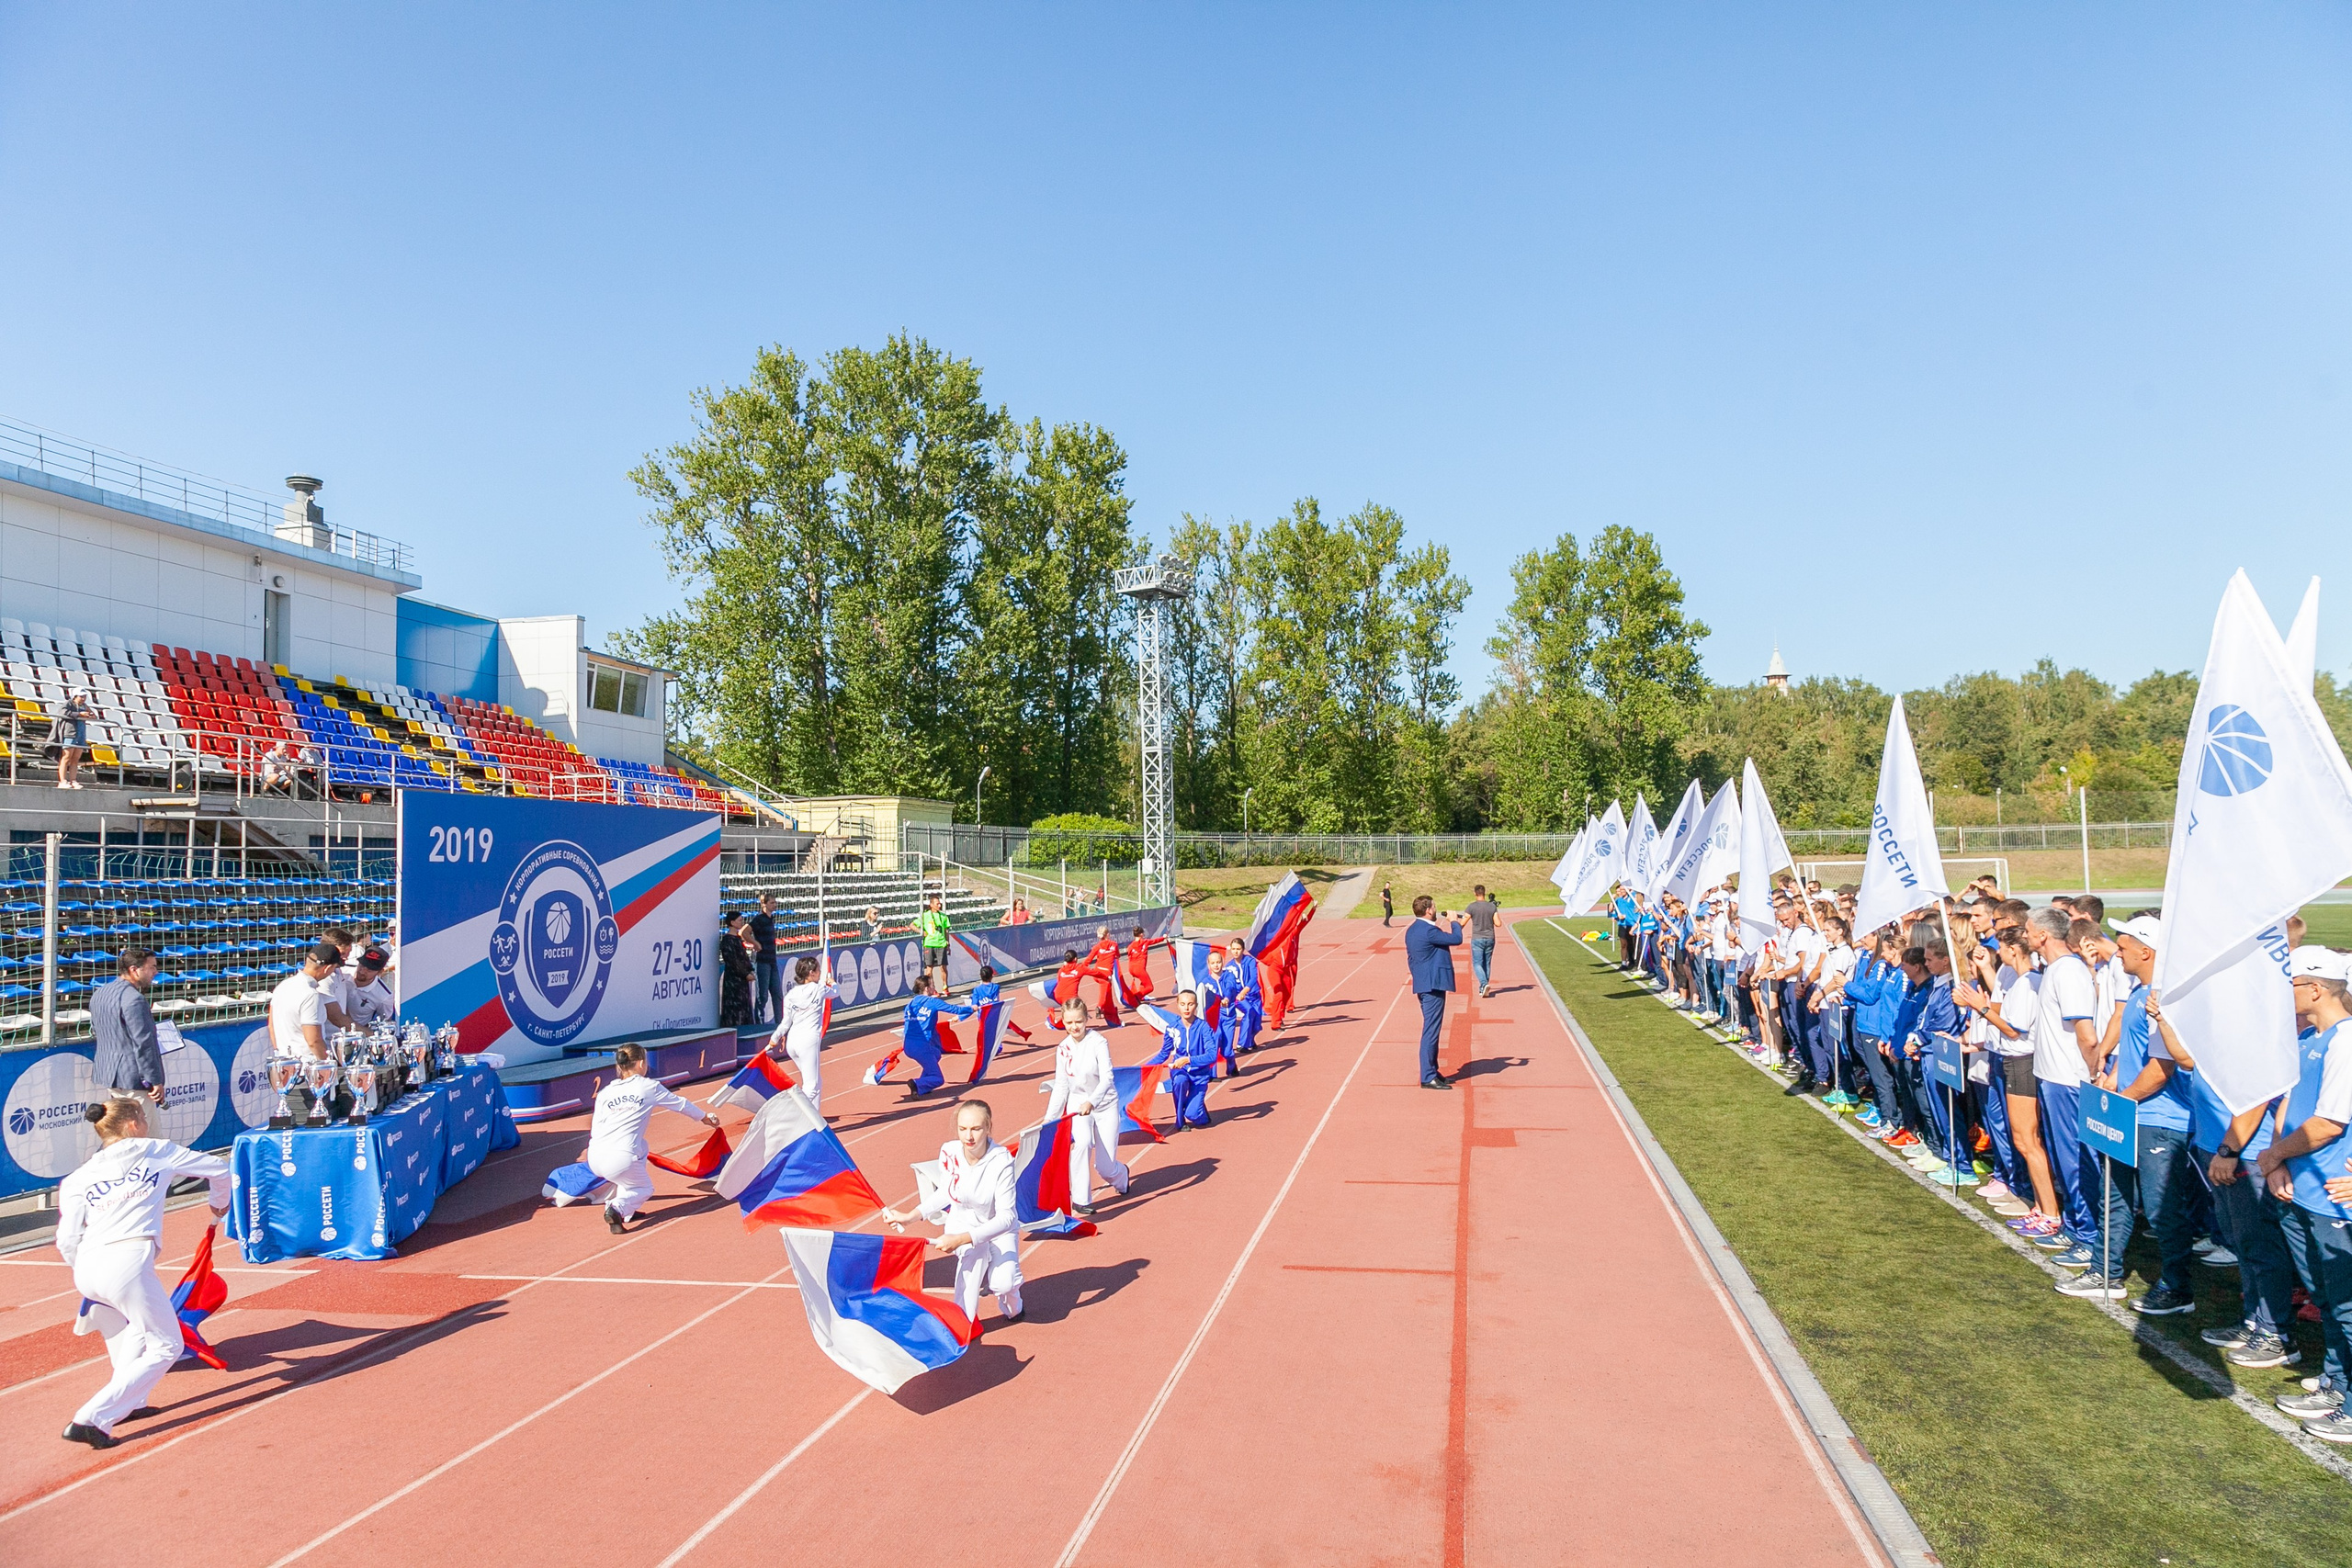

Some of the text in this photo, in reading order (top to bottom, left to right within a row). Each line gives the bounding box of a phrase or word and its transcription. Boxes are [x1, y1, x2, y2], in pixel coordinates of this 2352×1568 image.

[429, 826, 493, 863] 2019
[1873, 804, 1917, 888] РОССЕТИ
[514, 850, 601, 891] КОРПОРАТИВНЫЕ СОРЕВНОВАНИЯ
[544, 947, 573, 959] РОССЕТИ
[652, 938, 702, 976] 27-30
[551, 974, 564, 983] 2019
[652, 976, 702, 1001] АВГУСТА
[534, 1012, 584, 1039] САНКТ-ПЕТЕРБУРГ
[698, 1049, 706, 1068] 1
[165, 1082, 205, 1098] РОССЕТИ
[592, 1076, 601, 1099] 2
[39, 1101, 87, 1120] РОССЕТИ
[167, 1094, 206, 1107] ЕВЕРО-ЗАПАД
[607, 1094, 645, 1109] RUSSIA
[39, 1115, 82, 1131] МОСКОВСКИЙ
[282, 1130, 293, 1160] РОССЕ
[356, 1126, 366, 1154] РОСС
[250, 1187, 260, 1228] РОССЕТИ
[322, 1186, 333, 1225] РОССЕТИ
